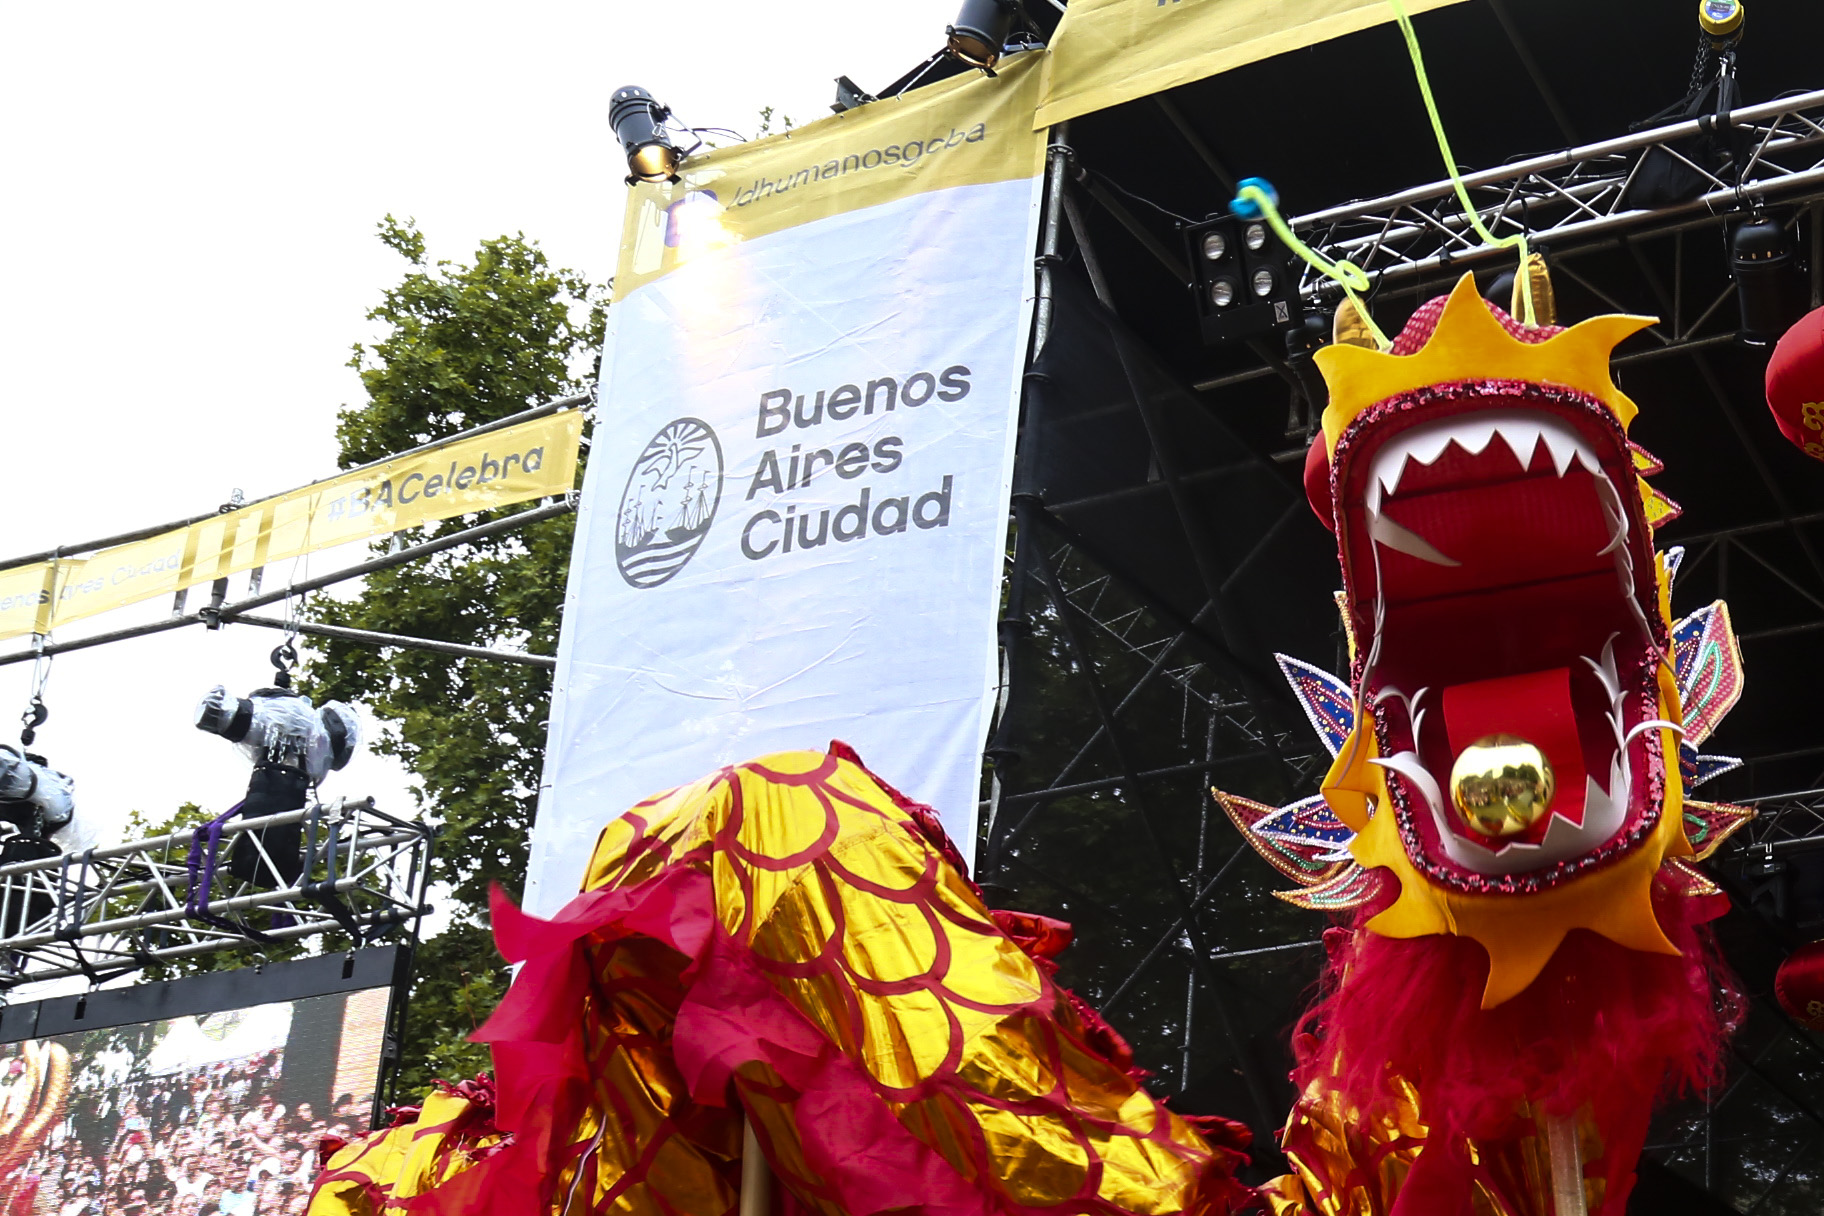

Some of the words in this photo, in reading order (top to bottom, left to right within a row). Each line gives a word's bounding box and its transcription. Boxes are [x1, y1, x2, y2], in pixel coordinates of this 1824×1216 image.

[756, 365, 972, 438] Buenos
[328, 446, 545, 521] #BACelebra
[745, 436, 904, 501] Aires
[740, 475, 953, 560] Ciudad
